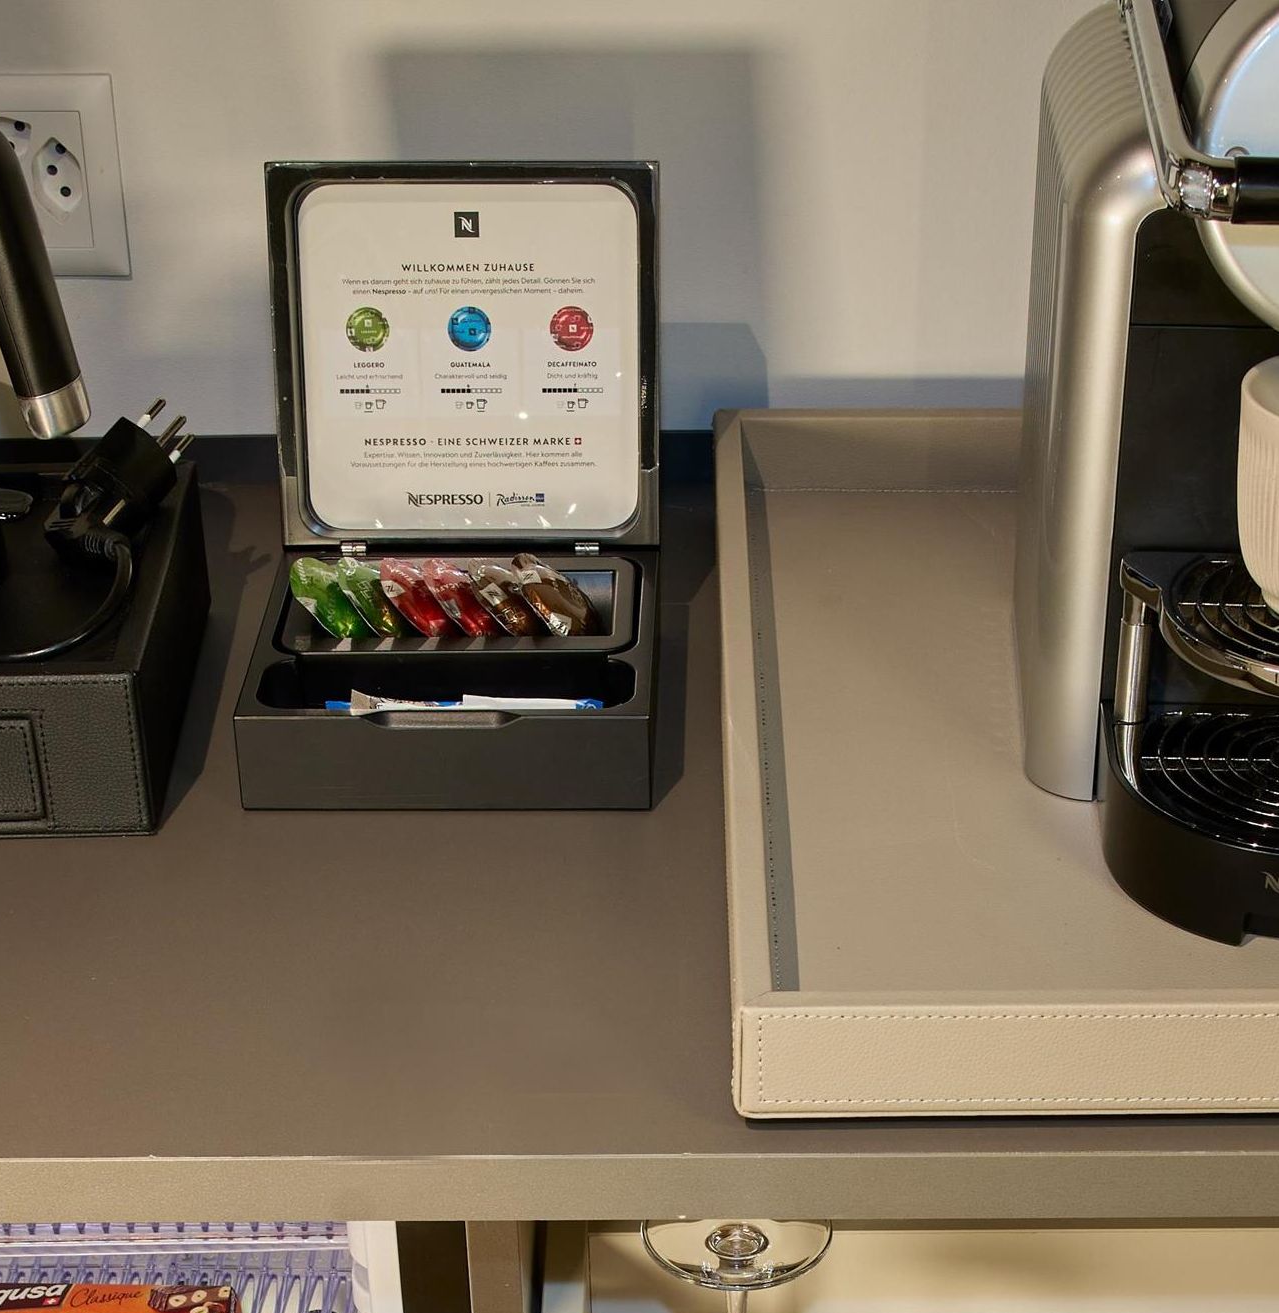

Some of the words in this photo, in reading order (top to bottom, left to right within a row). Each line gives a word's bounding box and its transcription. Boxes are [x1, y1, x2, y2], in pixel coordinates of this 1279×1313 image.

[401, 263, 480, 272] WILLKOMMEN
[484, 263, 535, 272] ZUHAUSE
[372, 288, 407, 296] Nespresso
[364, 438, 426, 446] NESPRESSO
[465, 437, 529, 446] SCHWEIZER
[532, 437, 571, 445] MARKE
[406, 492, 484, 507] NESPRESSO
[496, 492, 535, 506] Radisson
[70, 1286, 144, 1308] Classique
